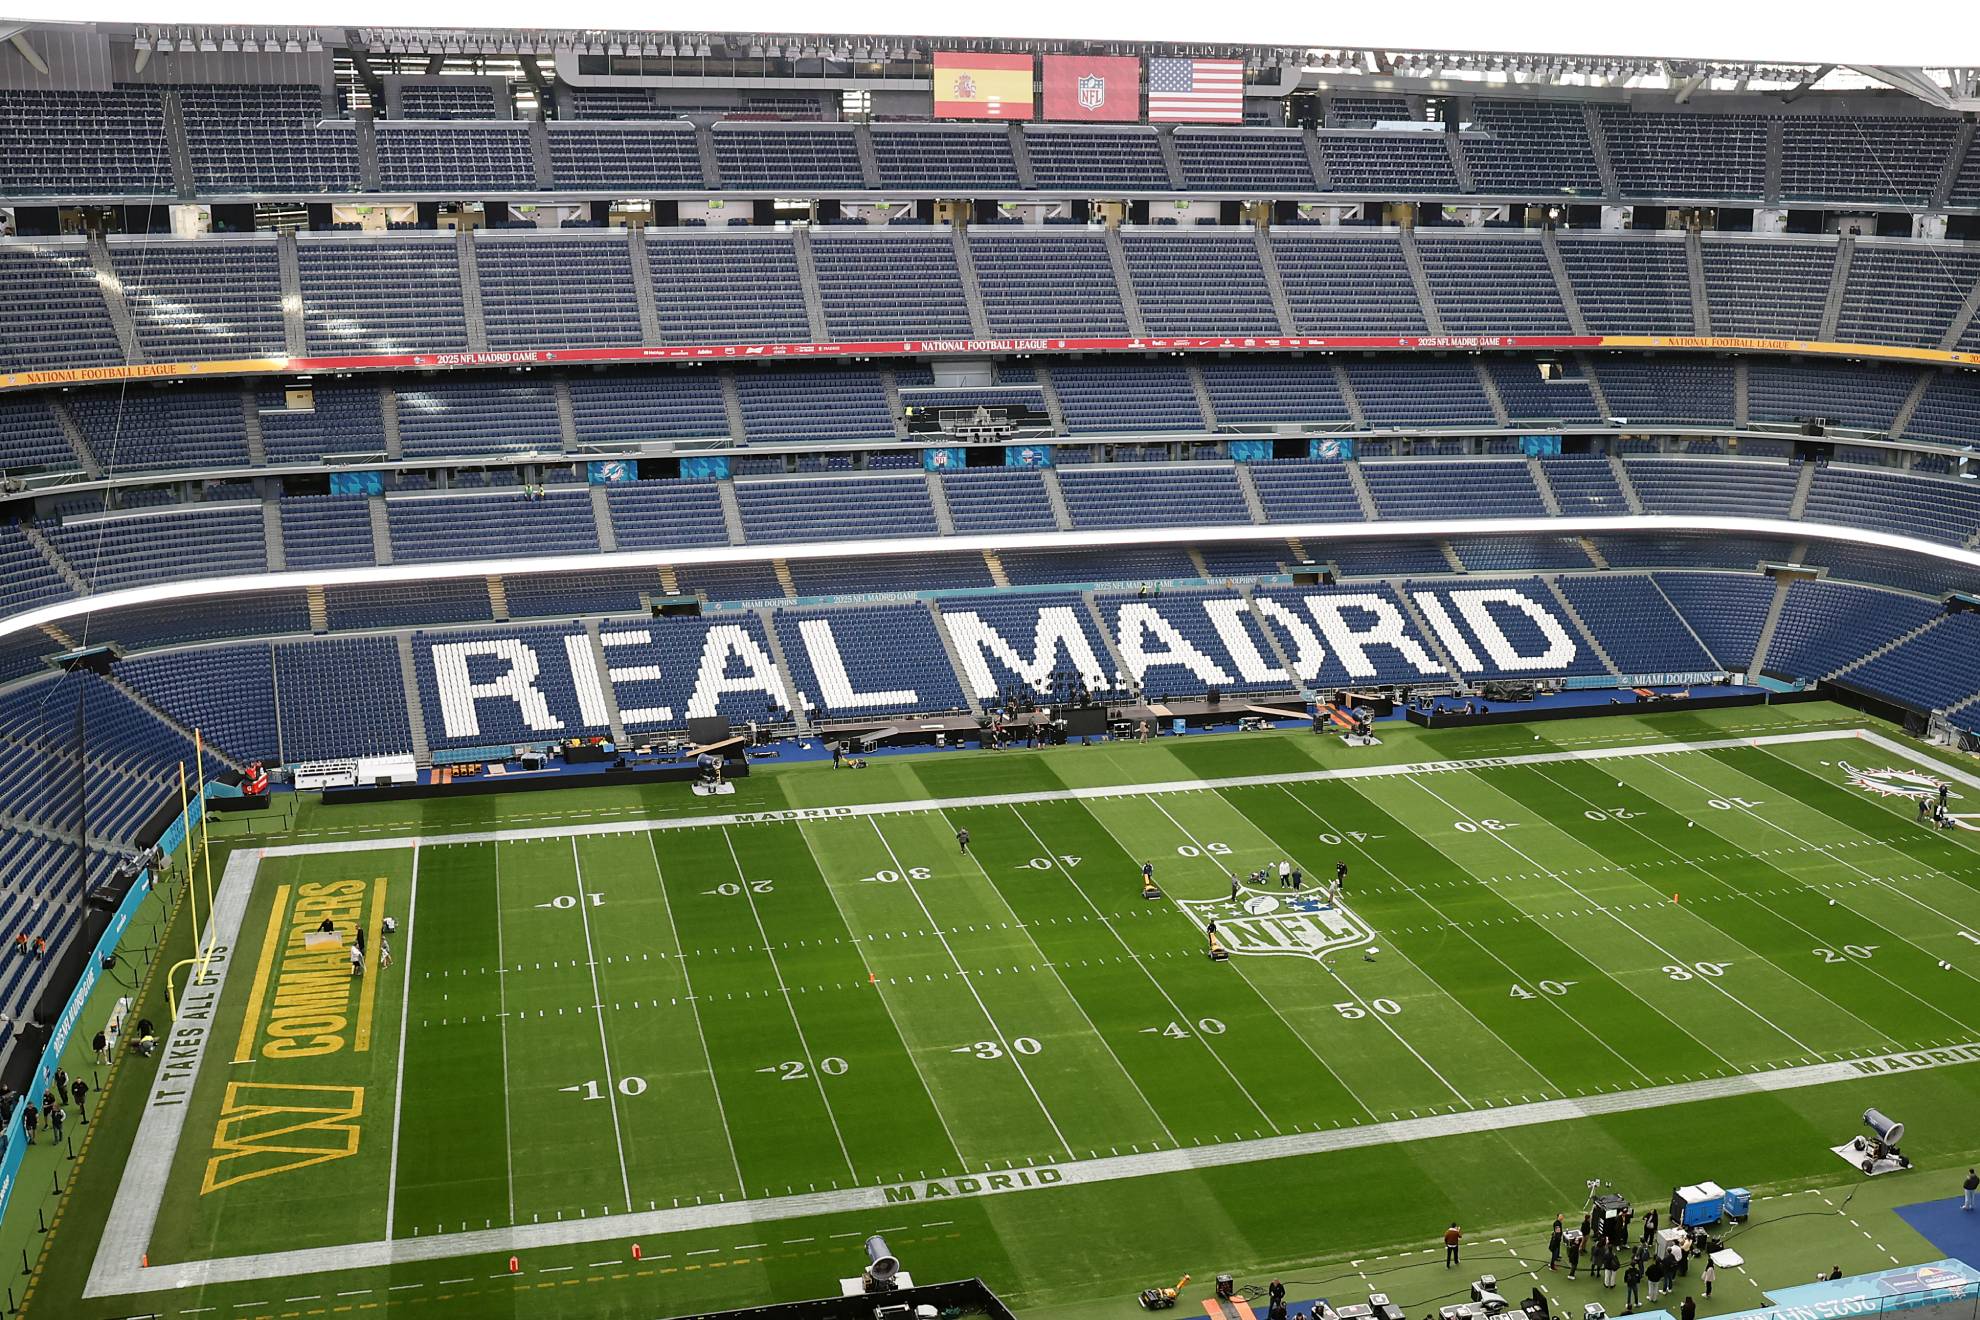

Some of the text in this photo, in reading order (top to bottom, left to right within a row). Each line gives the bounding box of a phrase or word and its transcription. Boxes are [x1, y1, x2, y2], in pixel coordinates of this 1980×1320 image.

[1081, 89, 1102, 105] NFL
[921, 339, 1048, 351] NATIONAL FOOTBALL LEAGUE
[1418, 337, 1500, 346] 2025 NFL MADRID GAME
[1668, 337, 1790, 349] NATIONAL FOOTBALL LEAGUE
[437, 351, 538, 365] 2025 NFL MADRID GAME
[27, 364, 177, 383] NATIONAL FOOTBALL LEAGUE
[742, 598, 798, 608] MIAMI DOLPHINS
[833, 591, 918, 604] 2025 NFL MADRID GAME
[431, 589, 1577, 738] REAL MADRID
[1633, 671, 1712, 685] MIAMI DOLPHINS
[1407, 758, 1507, 772] MADRID
[735, 807, 852, 822] MADRID
[1219, 913, 1358, 948] NFL
[262, 878, 367, 1060] COMMANDERS
[182, 991, 215, 1021] ALL
[161, 1027, 205, 1083] TAKES
[1849, 1046, 1980, 1075] MADRID
[153, 1089, 186, 1107] IT
[883, 1168, 1064, 1203] MADRID
[1814, 1294, 1877, 1318] 2025
